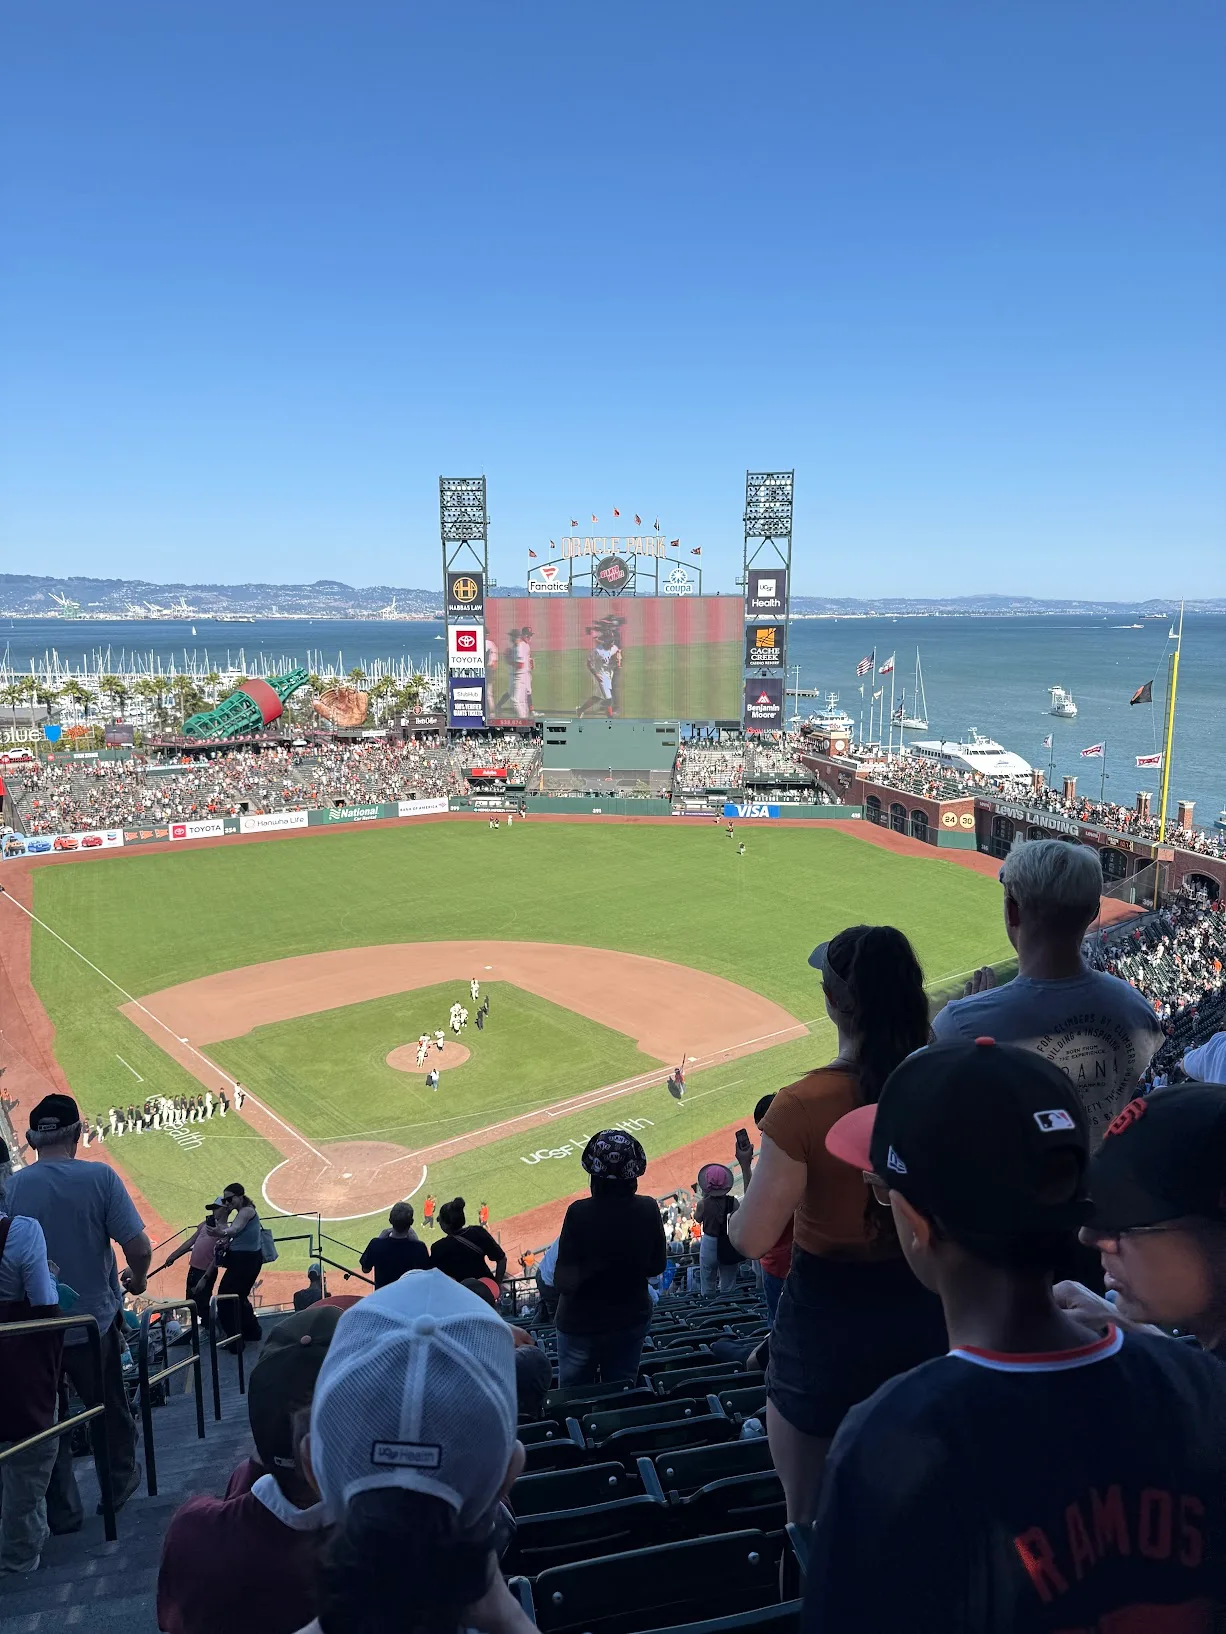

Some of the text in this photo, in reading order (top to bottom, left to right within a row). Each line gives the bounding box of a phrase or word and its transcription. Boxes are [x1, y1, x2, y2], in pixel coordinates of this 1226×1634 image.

[562, 536, 666, 558] ORACLE PARK
[530, 582, 569, 590] Fanatics
[665, 585, 691, 594] coupa
[752, 599, 780, 607] Health
[341, 806, 379, 818] National
[735, 805, 769, 818] VISA
[962, 817, 972, 825] 30
[1026, 813, 1079, 836] LANDING
[189, 825, 221, 833] TOYOTA
[1036, 1013, 1136, 1064] FOR CLIMBERS BY CLIMBERS
[1047, 1031, 1075, 1060] UILDING
[520, 1144, 574, 1164] UCSF
[569, 1117, 655, 1150] Hlth
[1012, 1484, 1205, 1604] RAMOS
